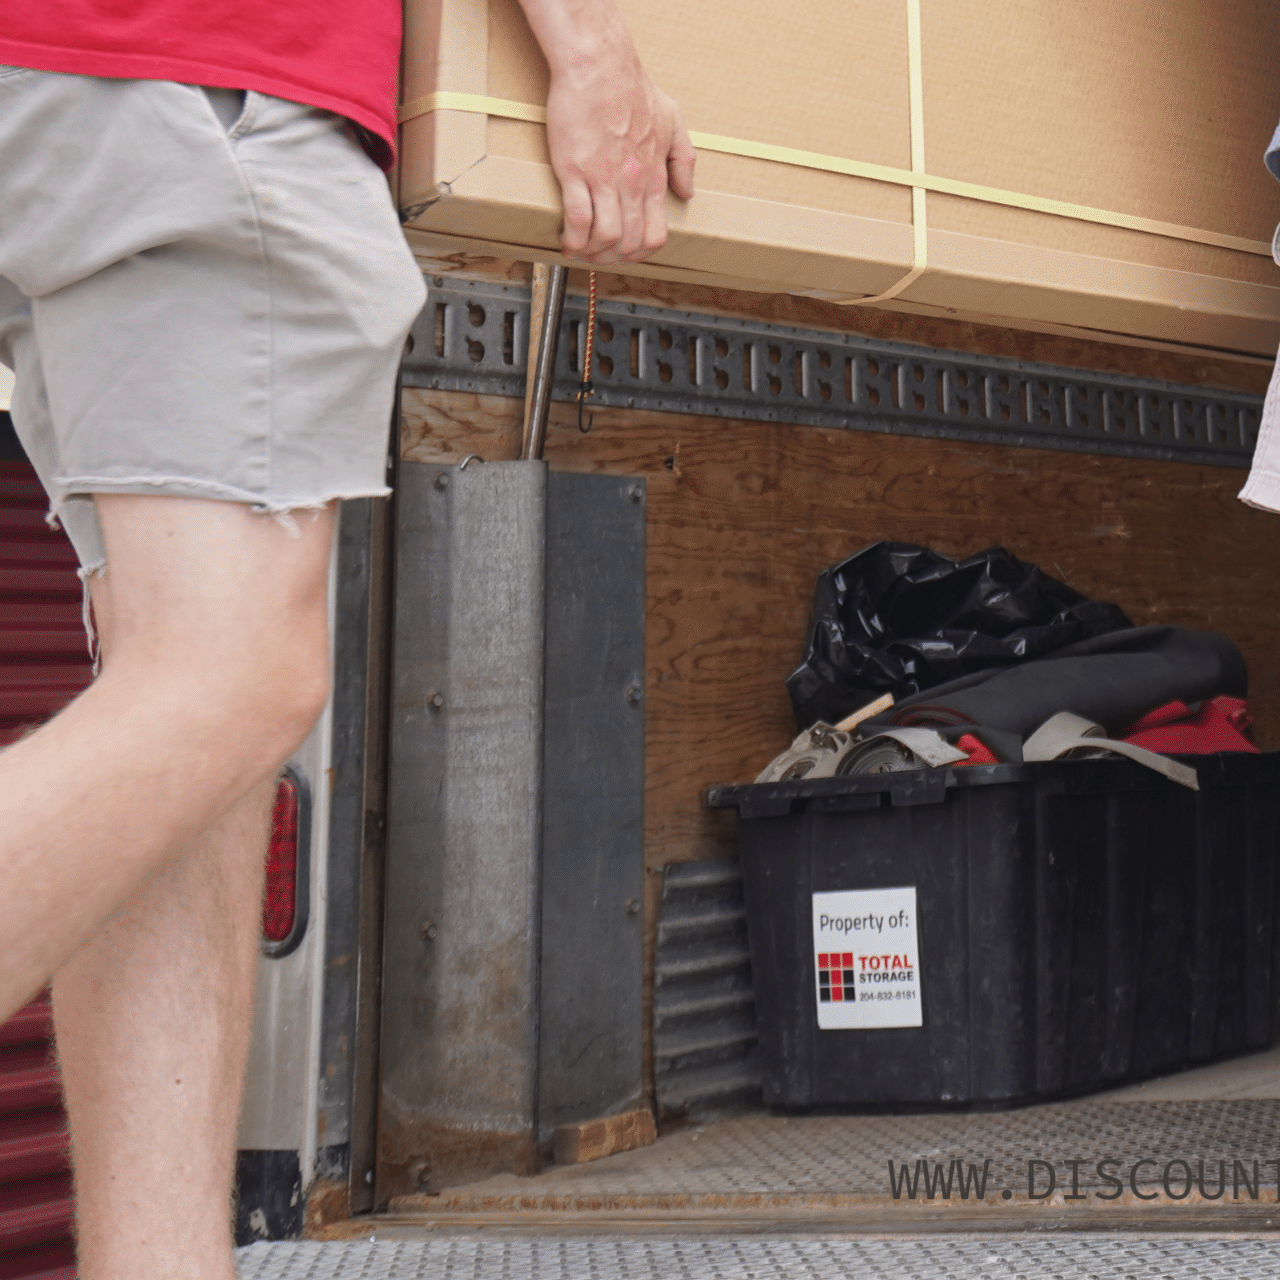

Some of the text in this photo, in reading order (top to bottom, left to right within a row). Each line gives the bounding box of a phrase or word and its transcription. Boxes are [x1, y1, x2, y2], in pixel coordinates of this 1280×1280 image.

[820, 910, 909, 935] Property of:
[858, 954, 913, 970] TOTAL
[859, 971, 914, 983] STORAGE
